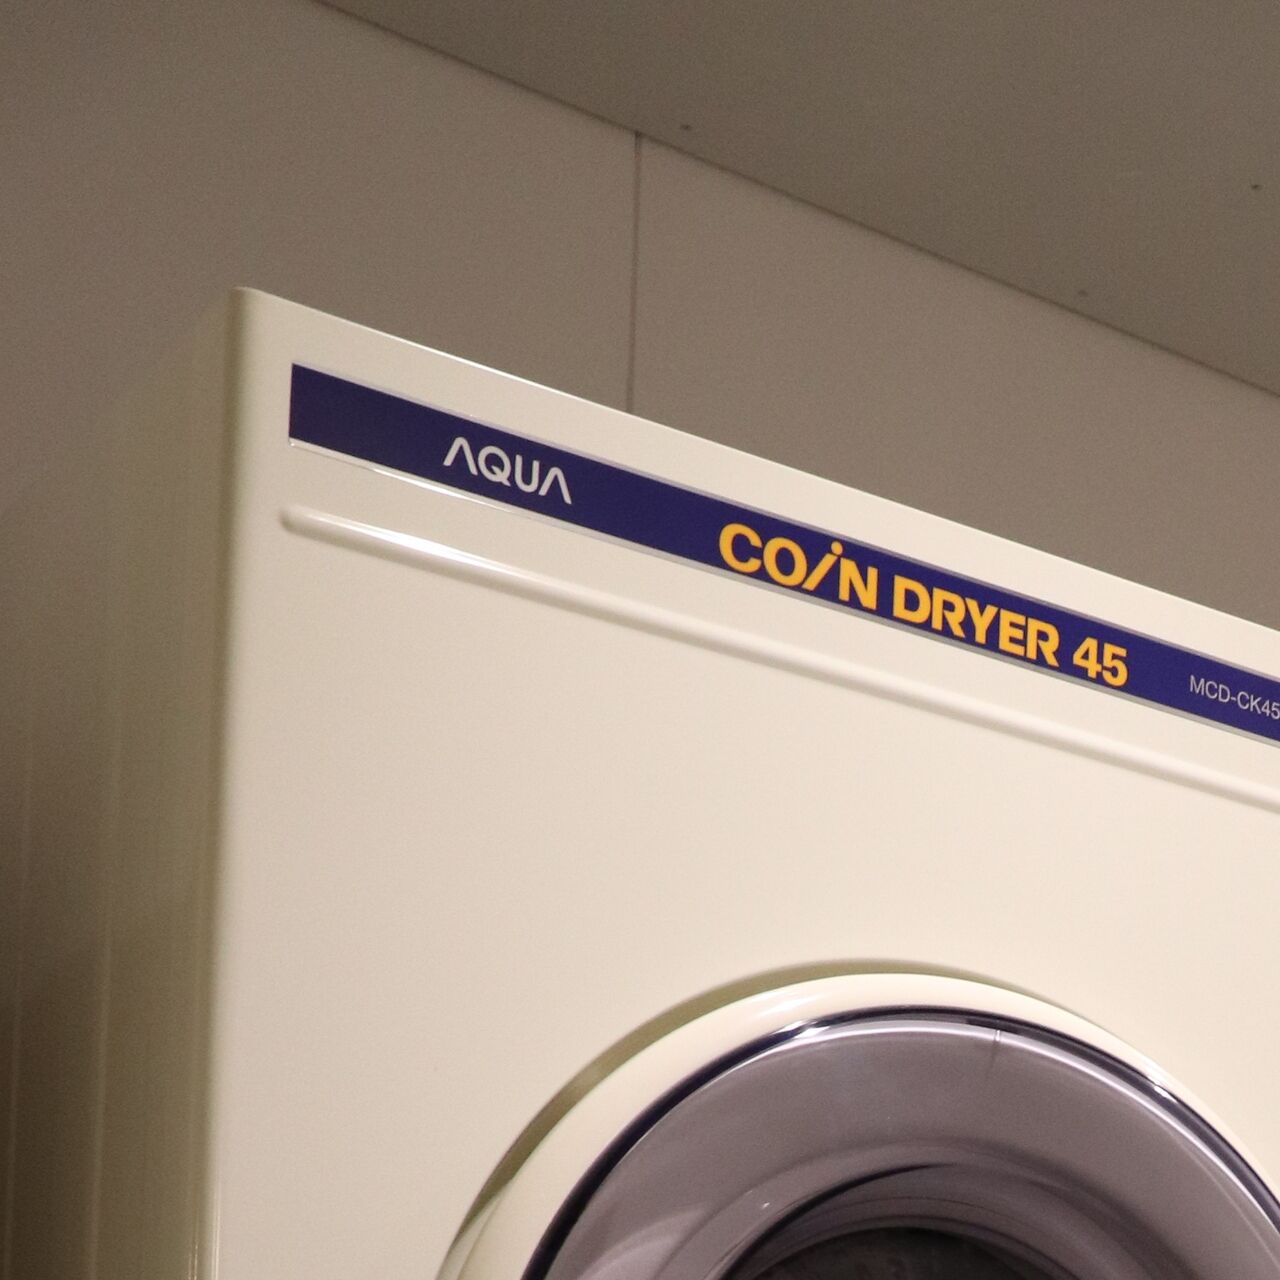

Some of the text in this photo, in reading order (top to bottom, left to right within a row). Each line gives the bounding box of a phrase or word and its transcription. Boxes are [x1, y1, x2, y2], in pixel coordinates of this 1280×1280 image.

[442, 436, 572, 505] AQUA
[893, 574, 1059, 667] DRYER
[1073, 636, 1129, 687] 45
